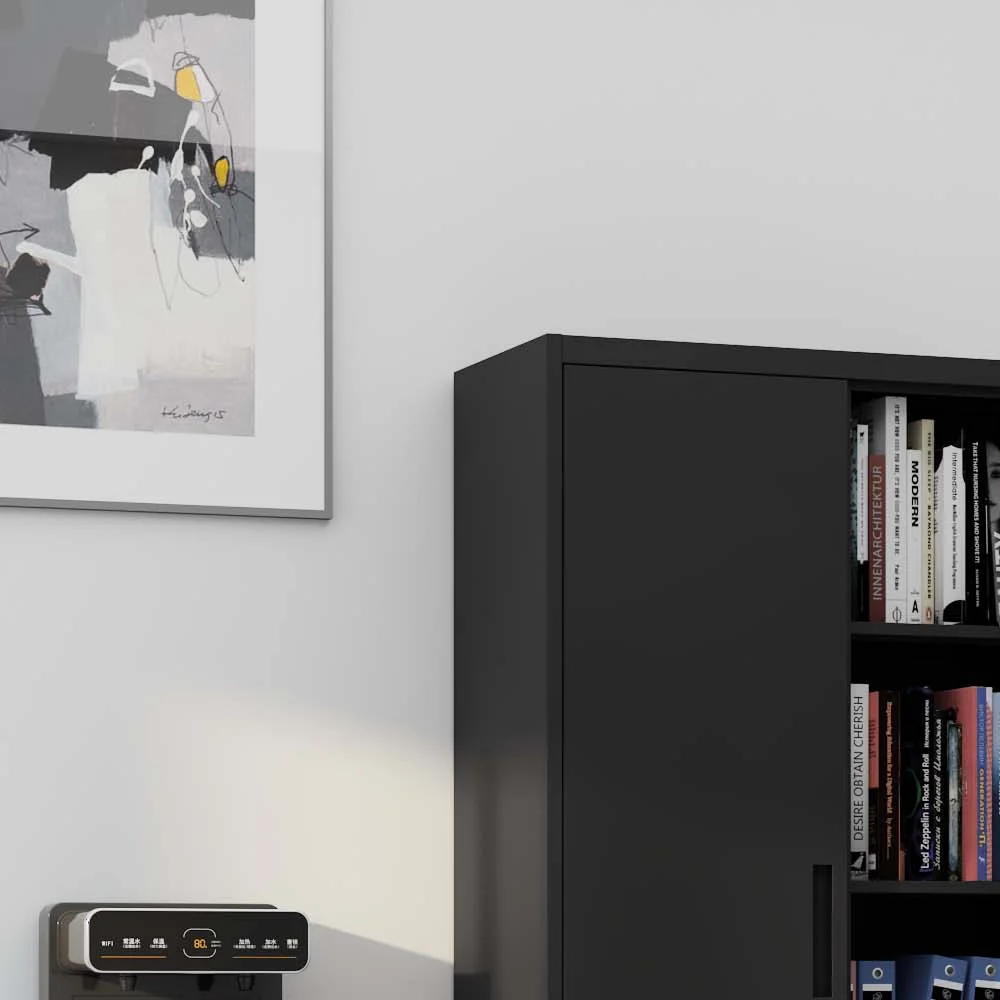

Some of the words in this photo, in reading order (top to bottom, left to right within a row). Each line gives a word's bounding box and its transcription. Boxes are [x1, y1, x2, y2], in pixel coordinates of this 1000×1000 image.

[911, 460, 920, 527] MODERN
[872, 466, 883, 600] INNENARCHITEKTUR
[853, 696, 864, 748] CHERISH
[853, 751, 864, 797] OBTAIN
[922, 753, 930, 768] Roll
[922, 769, 930, 783] and
[922, 784, 930, 802] Rock
[933, 775, 943, 812] берегов
[853, 801, 864, 842] DESIRE
[920, 812, 931, 850] Zeppelin
[921, 852, 930, 869] Led
[933, 827, 941, 871] Записки
